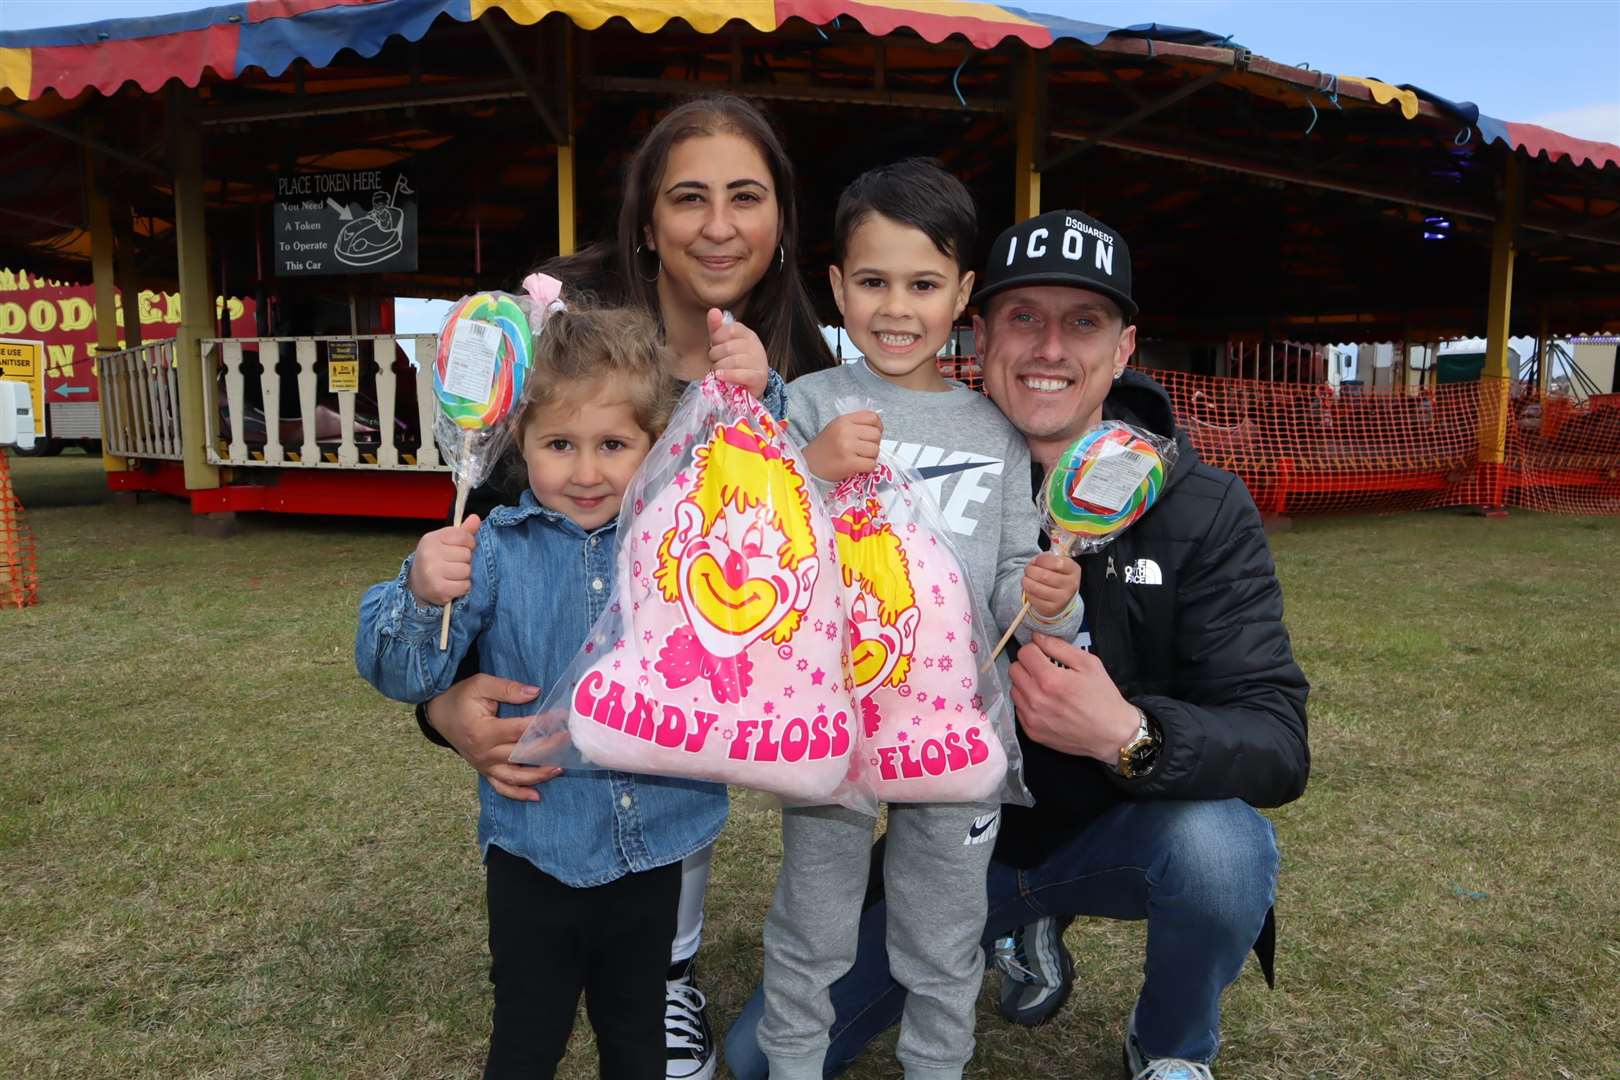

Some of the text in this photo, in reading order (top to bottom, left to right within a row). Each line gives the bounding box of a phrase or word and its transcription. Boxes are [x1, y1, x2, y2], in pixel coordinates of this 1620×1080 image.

[278, 171, 382, 195] PLACE TOKEN HERE
[282, 200, 324, 211] You Need
[284, 221, 321, 231] A Token
[1065, 216, 1113, 245] DSQUARED2
[279, 241, 328, 252] To Operate
[1006, 228, 1114, 276] ICON
[285, 260, 322, 271] This Car
[7, 348, 22, 356] USE
[574, 670, 850, 763] CANDY FLOSS
[876, 726, 990, 780] FLOSS
